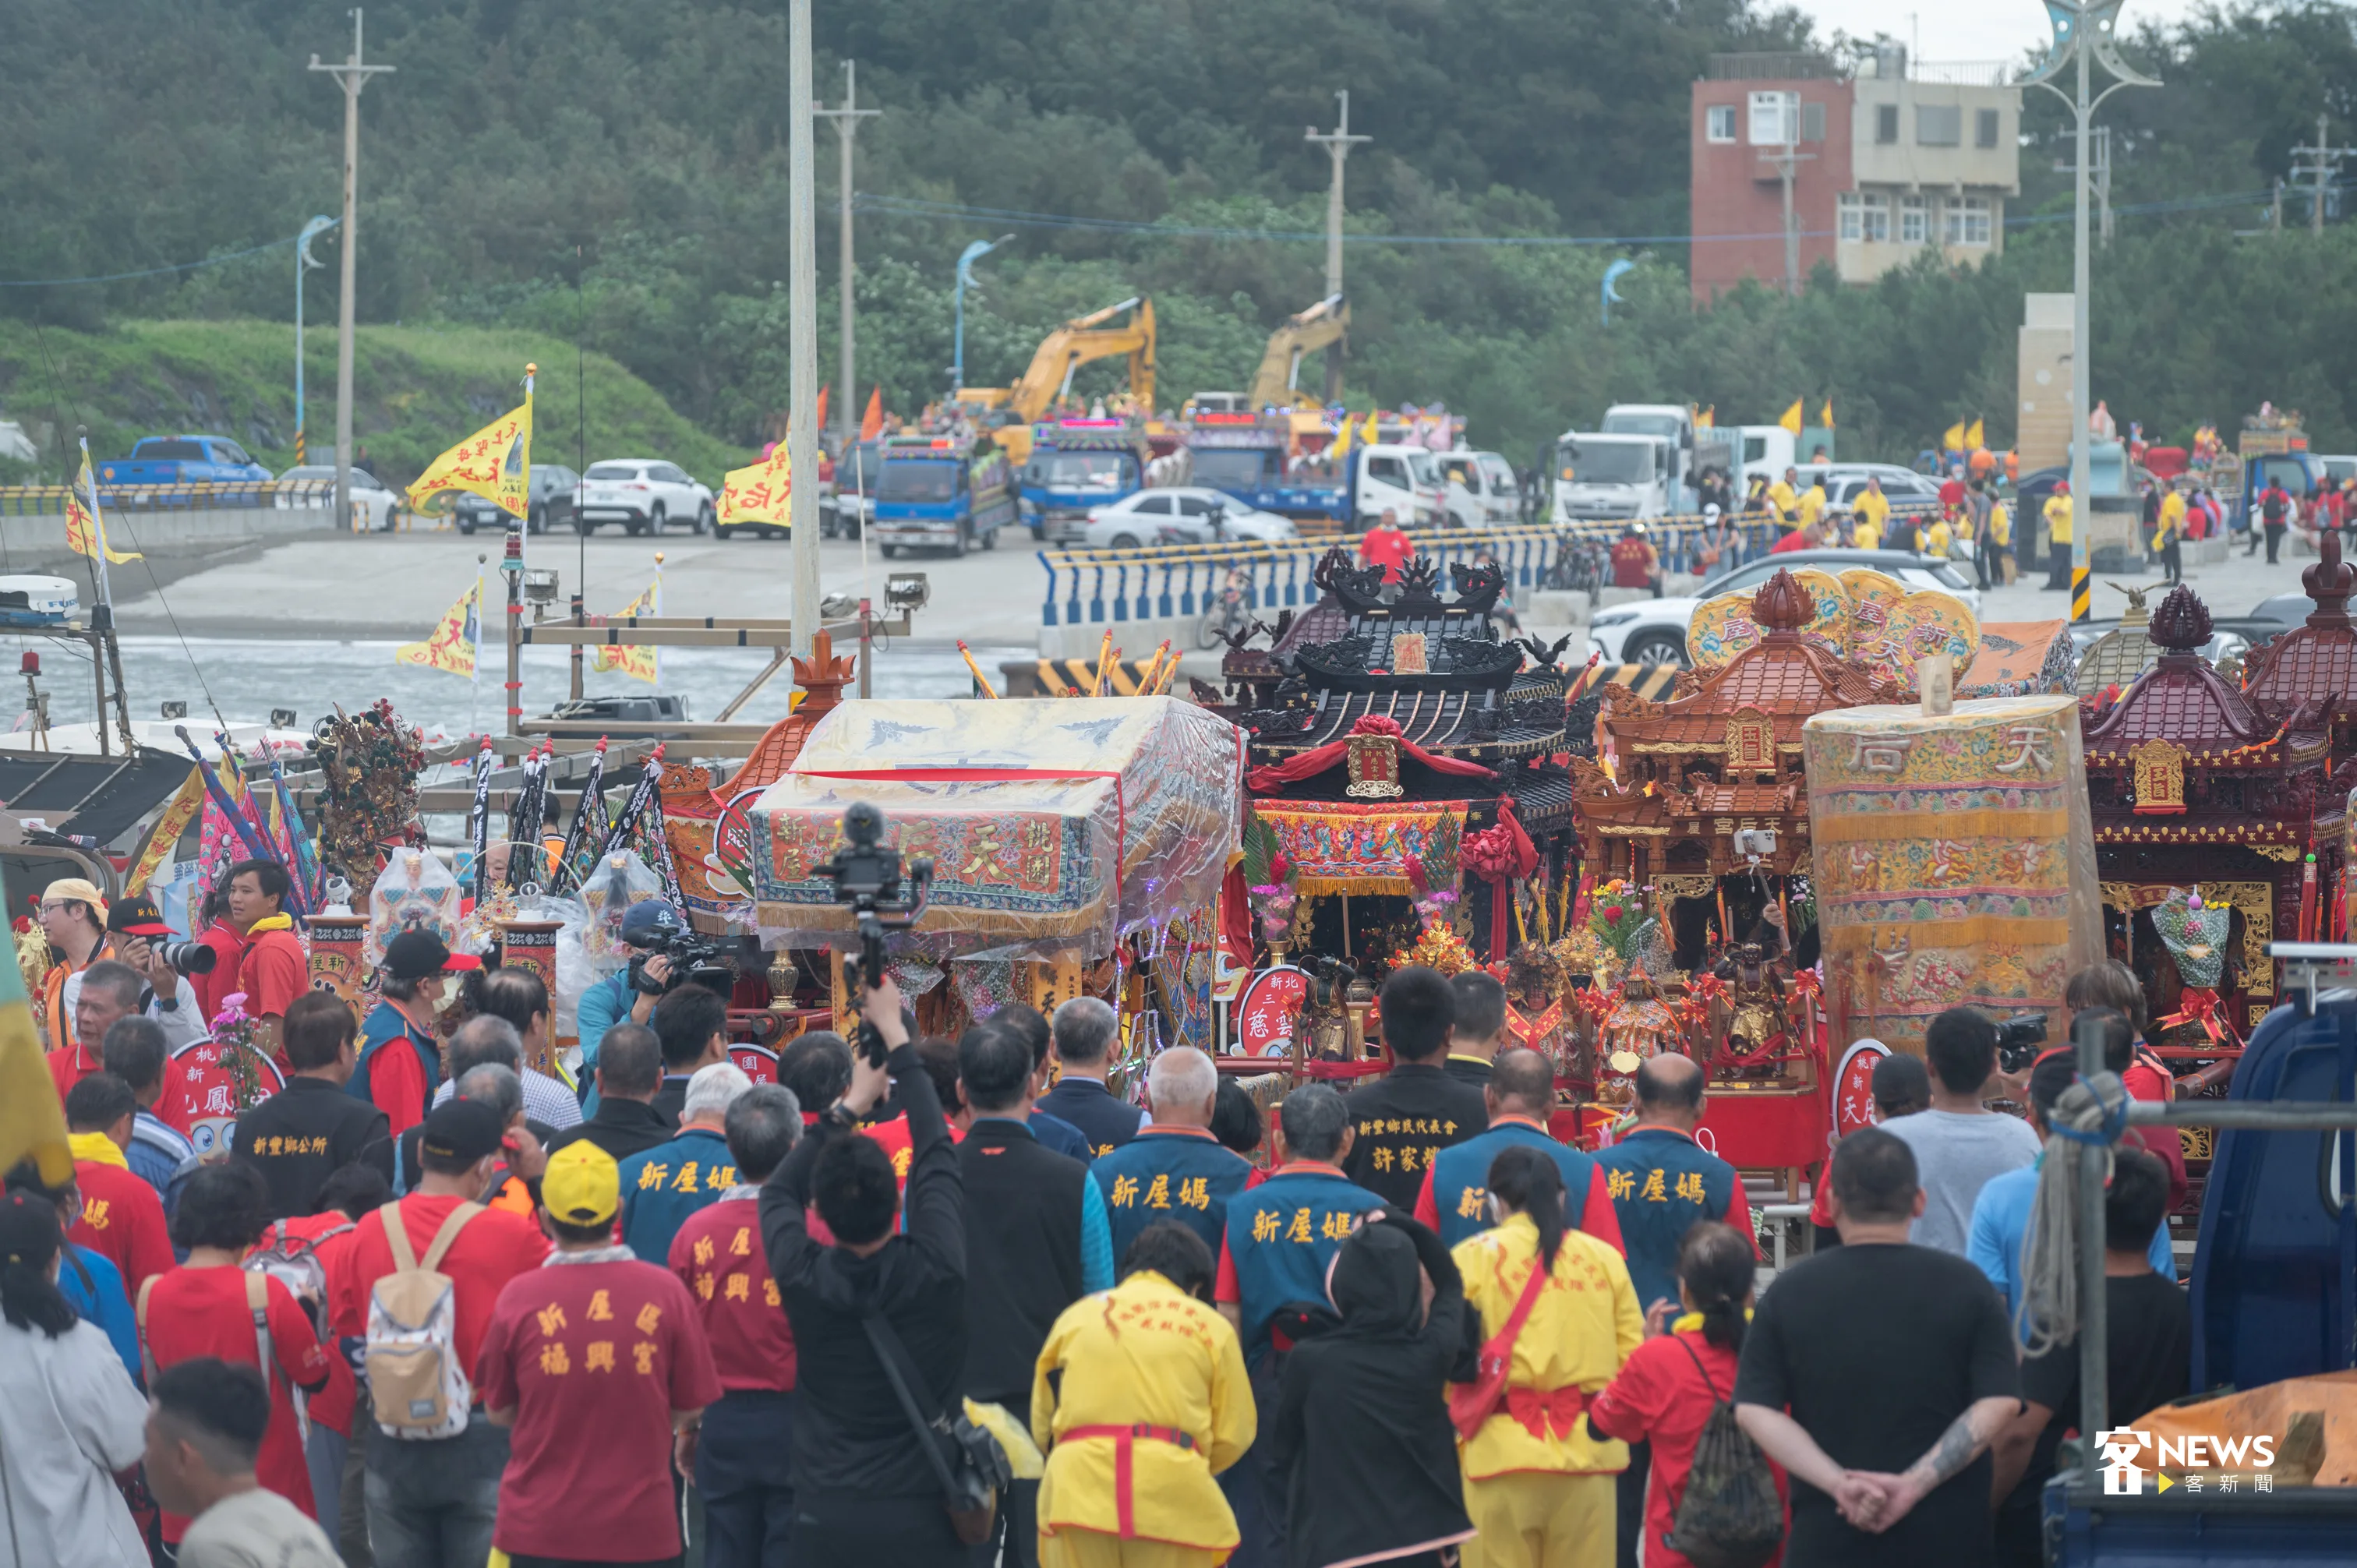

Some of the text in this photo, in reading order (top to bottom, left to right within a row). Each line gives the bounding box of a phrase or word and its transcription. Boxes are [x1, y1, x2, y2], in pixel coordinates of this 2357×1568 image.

[776, 812, 808, 881] 新屋
[1023, 817, 1055, 888] 桃園
[1270, 974, 1299, 991] 新北
[638, 1160, 738, 1194] 新屋媽
[1111, 1173, 1210, 1211] 新屋媽
[1606, 1167, 1706, 1206] 新屋媽
[1251, 1206, 1354, 1244] 新屋媽
[535, 1288, 663, 1337] 新屋區
[539, 1340, 659, 1376] 福興宮
